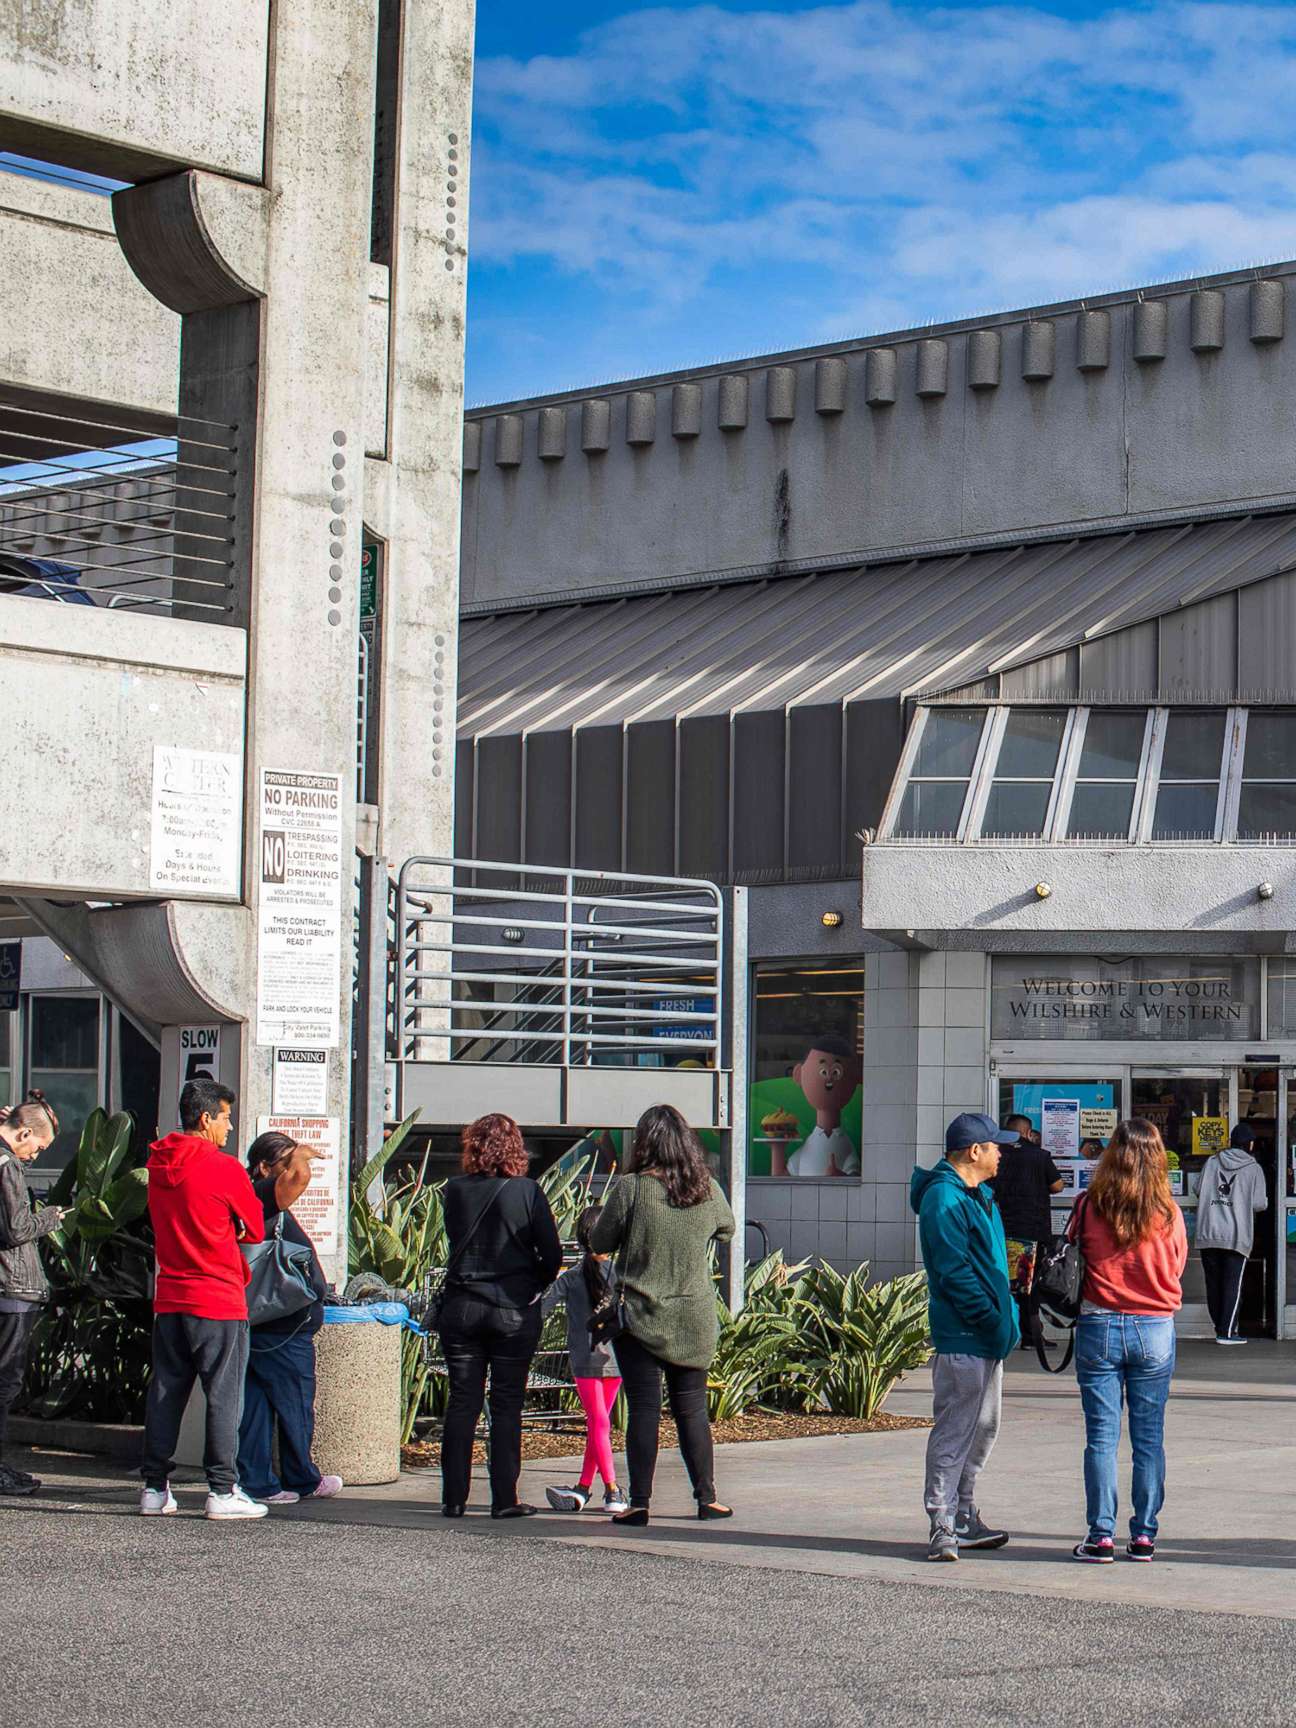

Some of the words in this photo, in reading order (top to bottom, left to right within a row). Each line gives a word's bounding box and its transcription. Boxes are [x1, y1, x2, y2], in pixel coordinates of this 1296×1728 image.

[265, 772, 297, 786] PRIVATE
[297, 776, 338, 789] PROPERTY
[265, 788, 282, 805] NO
[285, 790, 338, 809] PARKING
[265, 807, 294, 817] Without
[296, 809, 338, 821] Permission
[287, 831, 338, 844] TRESPASSING
[263, 836, 285, 877] NO
[287, 850, 339, 862] LOITERING
[287, 868, 340, 880] DRINKING
[272, 916, 289, 925] THIS
[290, 917, 326, 927] CONTRACT
[264, 927, 286, 935] LIMITS
[287, 928, 303, 936] OUR
[304, 928, 335, 937] LIABILITY
[286, 938, 305, 946] READ
[306, 939, 313, 947] IT
[1022, 977, 1128, 997] WELCOME
[1137, 980, 1165, 997] TO
[1168, 980, 1233, 997] YOUR
[659, 999, 695, 1012] FRESH
[1010, 1000, 1114, 1019] WILSHIRE
[1119, 1002, 1137, 1019] &
[1143, 1001, 1242, 1020] WESTERN
[181, 1029, 219, 1049] SLOW
[279, 1051, 324, 1063] WARNING
[184, 1052, 214, 1083] 5
[269, 1117, 300, 1128] CALIFORNIA
[301, 1119, 329, 1129] SHOPPING
[308, 1130, 322, 1139] LAW
[1198, 1128, 1225, 1137] KEYS
